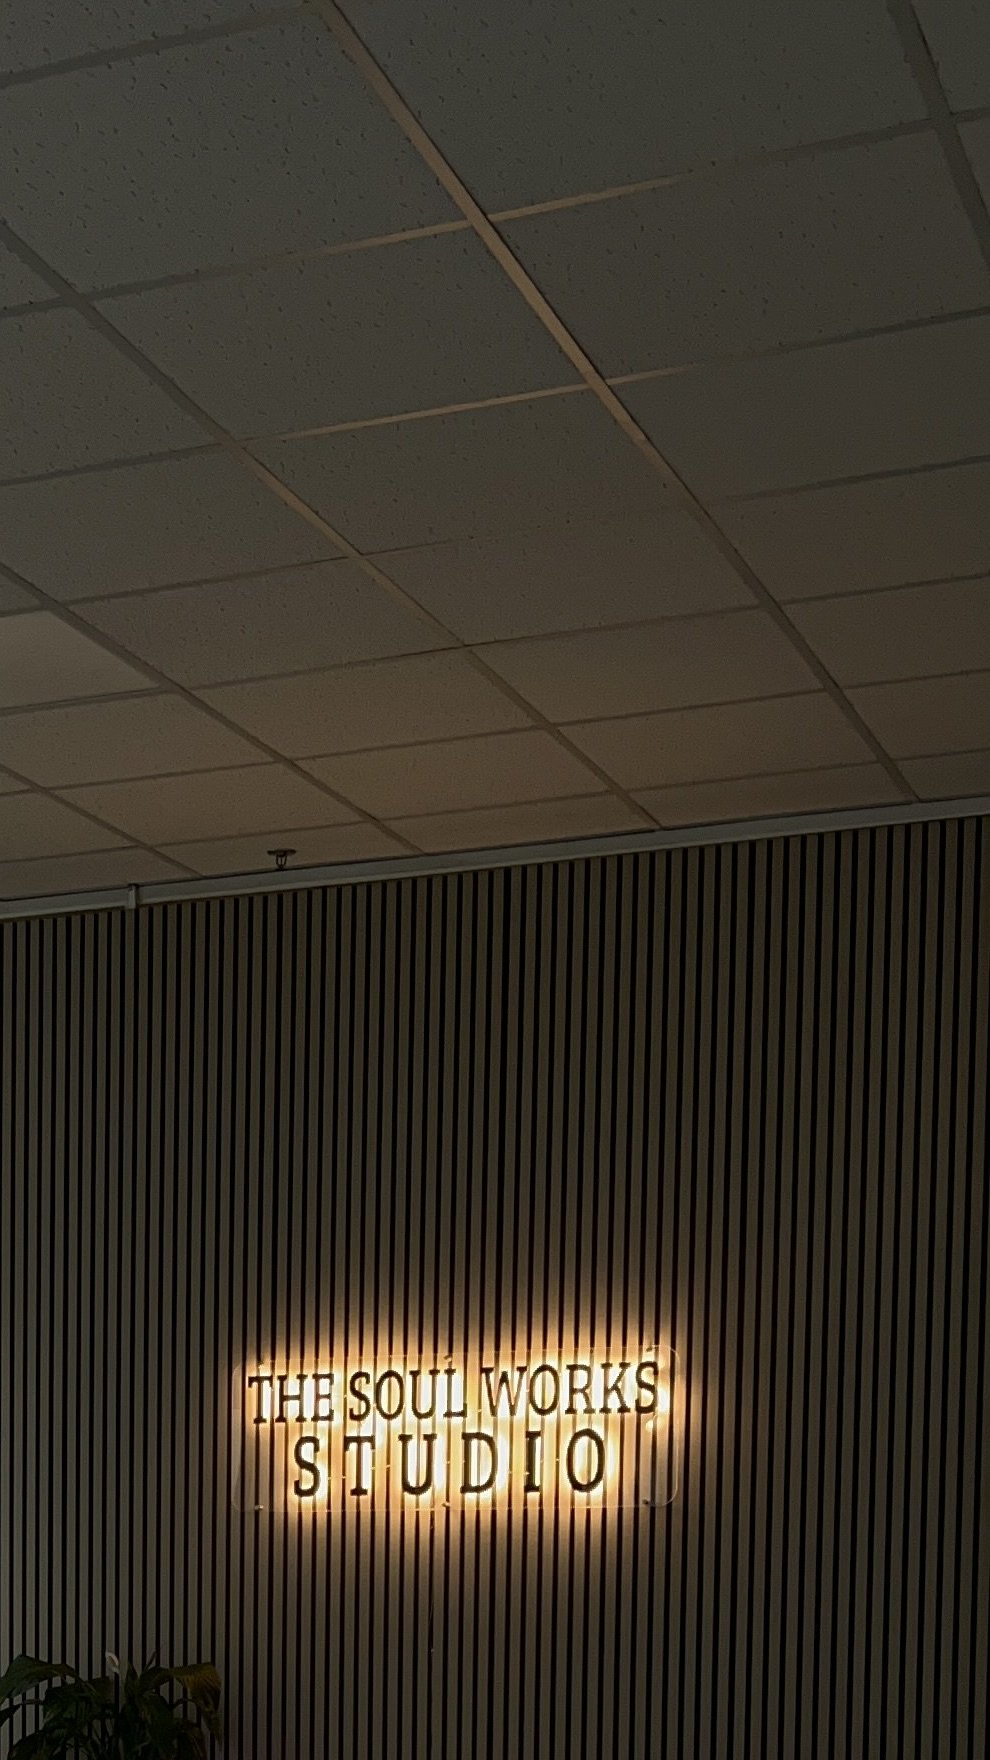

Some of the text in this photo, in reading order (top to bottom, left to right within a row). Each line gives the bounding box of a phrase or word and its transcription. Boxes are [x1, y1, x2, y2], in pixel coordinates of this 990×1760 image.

[248, 1361, 659, 1424] THE SOUL WORKS
[294, 1428, 606, 1497] STUDIO
